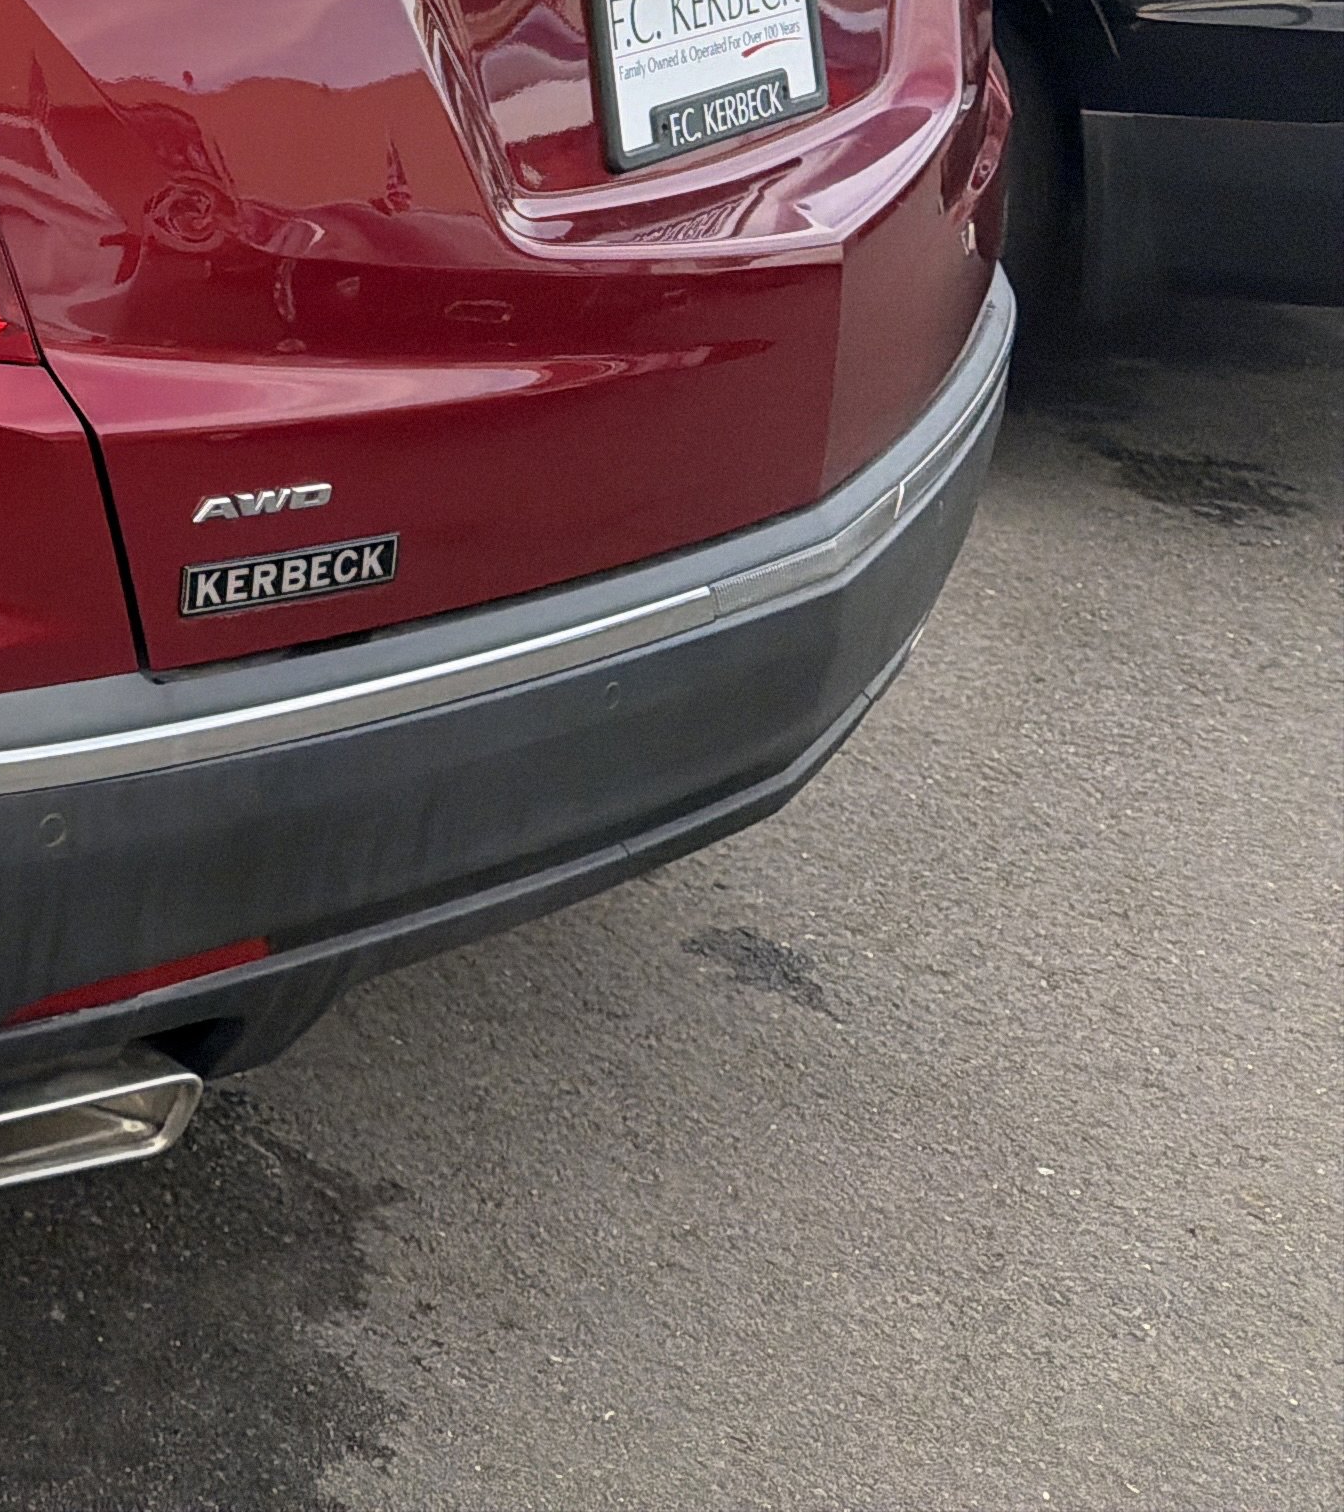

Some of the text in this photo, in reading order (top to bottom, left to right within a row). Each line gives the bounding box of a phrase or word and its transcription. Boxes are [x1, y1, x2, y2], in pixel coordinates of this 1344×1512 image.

[618, 20, 801, 81] Family Owned & Operated For Over 100 Years
[669, 81, 783, 147] F.C. KERBECK
[192, 482, 333, 525] AWD
[195, 544, 385, 608] KERBECK
